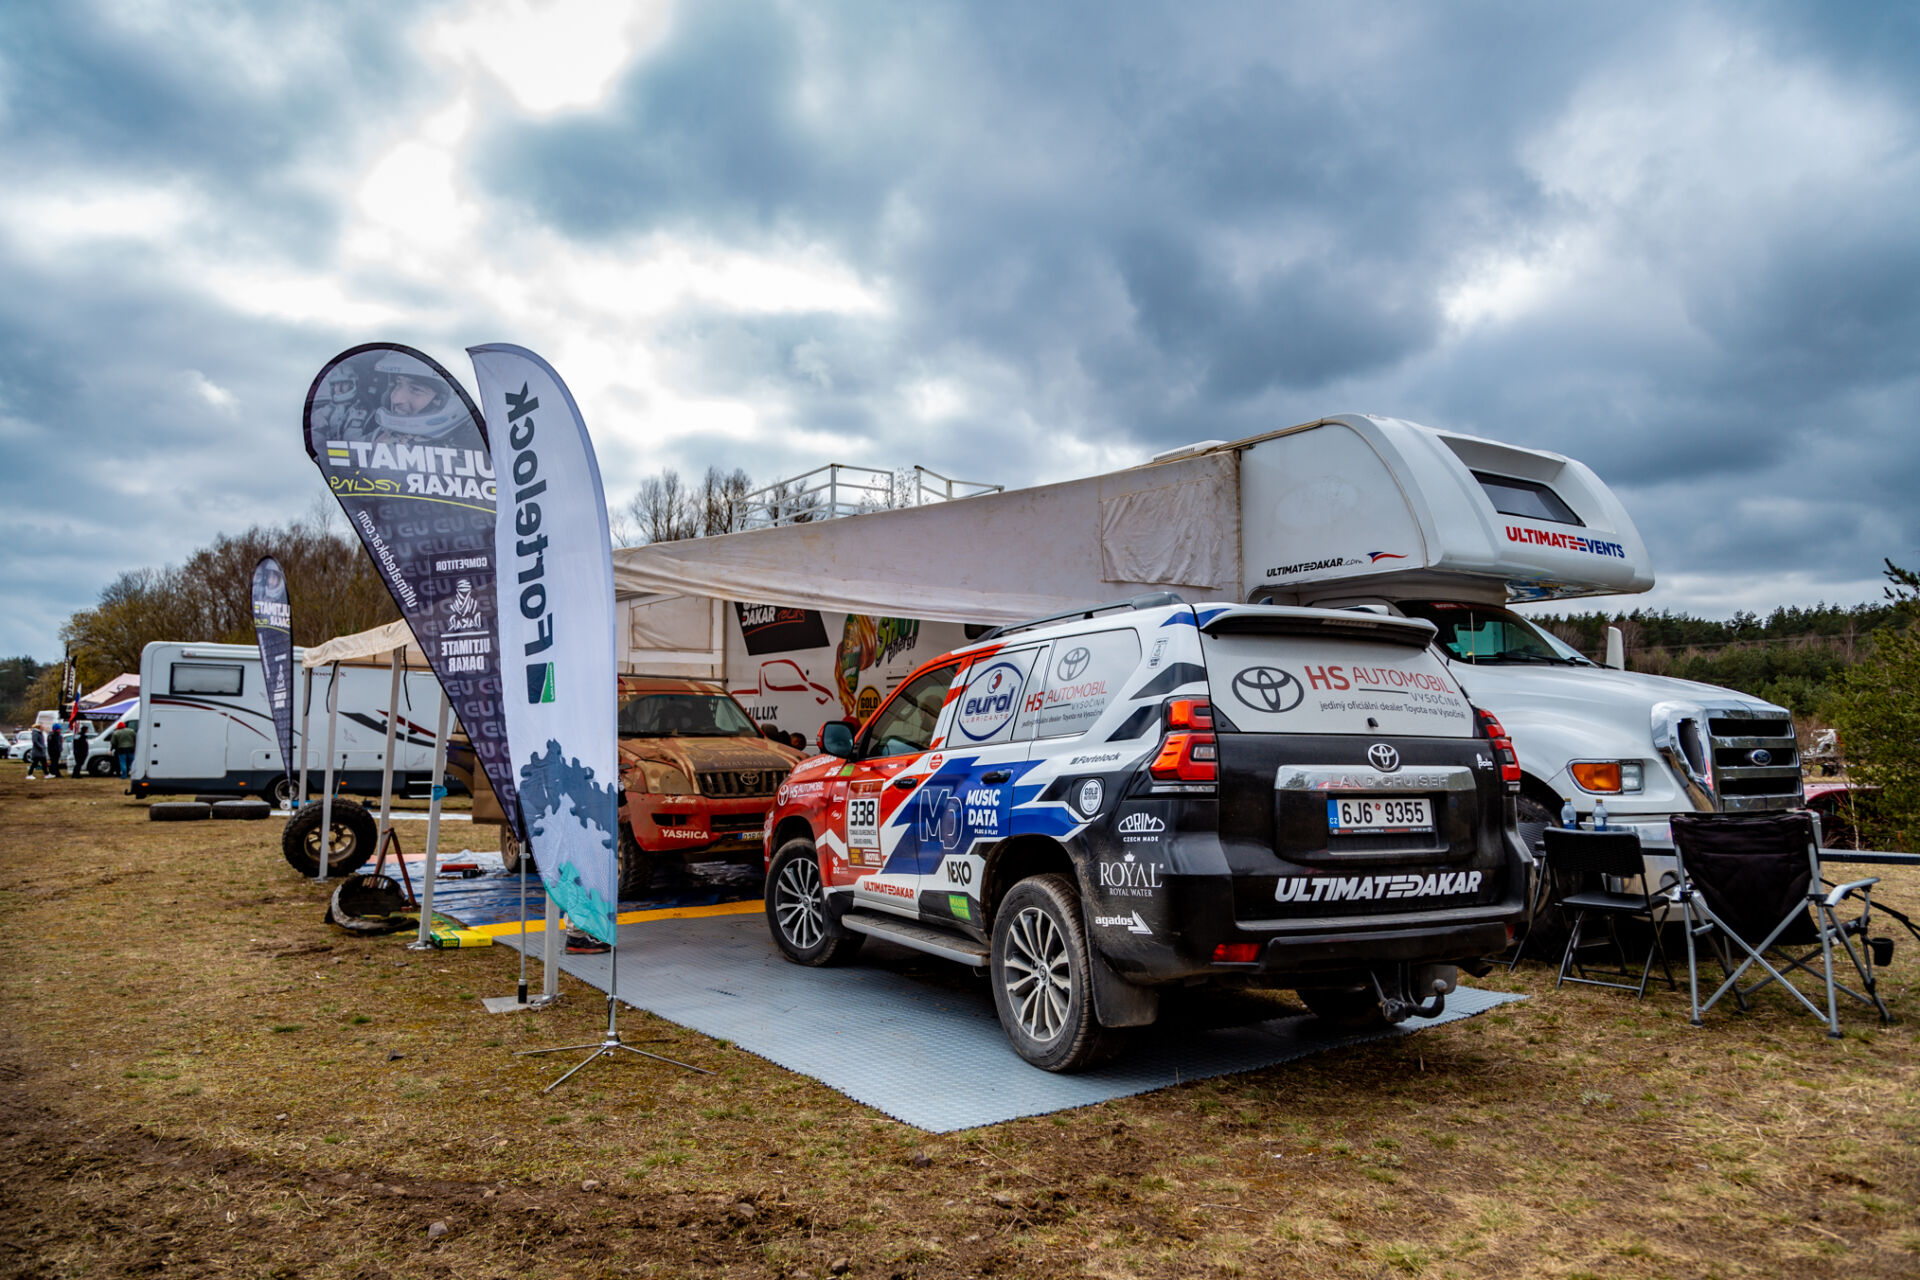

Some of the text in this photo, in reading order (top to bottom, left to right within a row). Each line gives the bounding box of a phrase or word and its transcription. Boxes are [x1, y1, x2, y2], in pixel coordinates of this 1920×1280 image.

[1304, 665, 1456, 694] HS AUTOMOBIL
[861, 697, 878, 709] GOLD
[965, 686, 1016, 717] eurol
[1024, 680, 1107, 713] HS AUTOMOBIL
[1404, 704, 1428, 714] Toyota
[962, 713, 1009, 724] LUBRICANTS
[1329, 775, 1448, 788] LAND CRUISER
[966, 788, 1001, 806] MUSIC
[850, 800, 875, 826] 338
[968, 809, 998, 827] DATA
[1125, 812, 1158, 831] PRIM
[1329, 817, 1338, 825] CZ
[1342, 802, 1424, 824] 6J6 9355
[662, 829, 708, 840] YASHICA
[946, 861, 972, 886] NEXO
[1100, 862, 1163, 888] ROYAL
[863, 881, 915, 900] ULTIMATEDAKAR
[1109, 888, 1153, 897] ROYAL WATER
[1274, 870, 1482, 902] ULTIMATEDAKAR
[1095, 914, 1133, 927] agados
